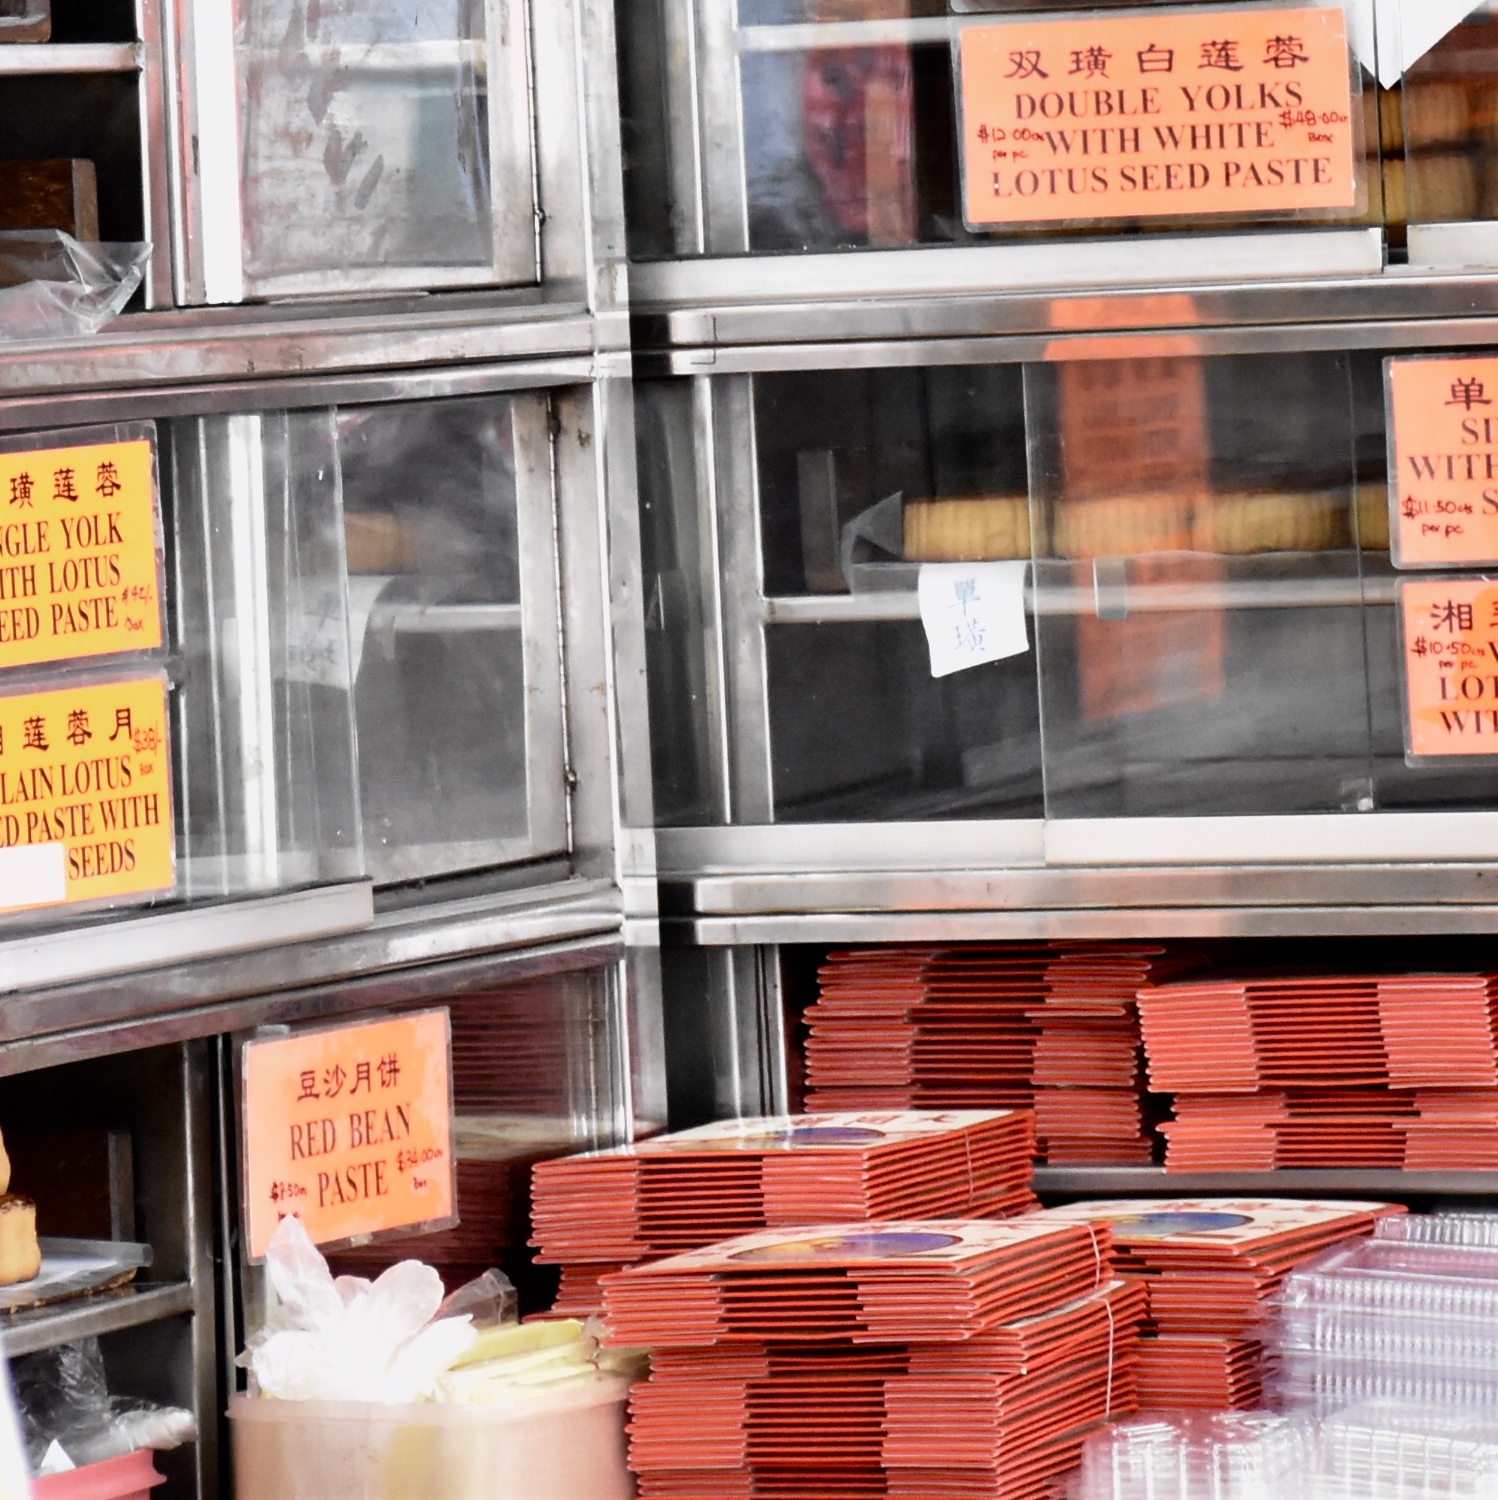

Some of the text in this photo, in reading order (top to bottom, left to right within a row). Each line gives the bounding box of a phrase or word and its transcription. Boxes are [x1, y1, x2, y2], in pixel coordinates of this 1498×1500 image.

[1015, 82, 1303, 120] DOUBLE YOLKS
[1046, 122, 1276, 156] WITH WHITE
[992, 157, 1332, 198] LOTUS SEED PASTE
[60, 511, 124, 551] YOLK
[48, 554, 121, 594] LOTUS
[51, 595, 119, 637] PASTE
[59, 755, 133, 797] LOTUS
[25, 803, 95, 844] PASTE
[100, 793, 160, 830] WITH
[68, 839, 136, 881] SEEDS
[290, 1103, 411, 1162] RED BEAN
[318, 1160, 388, 1208] PASTE
